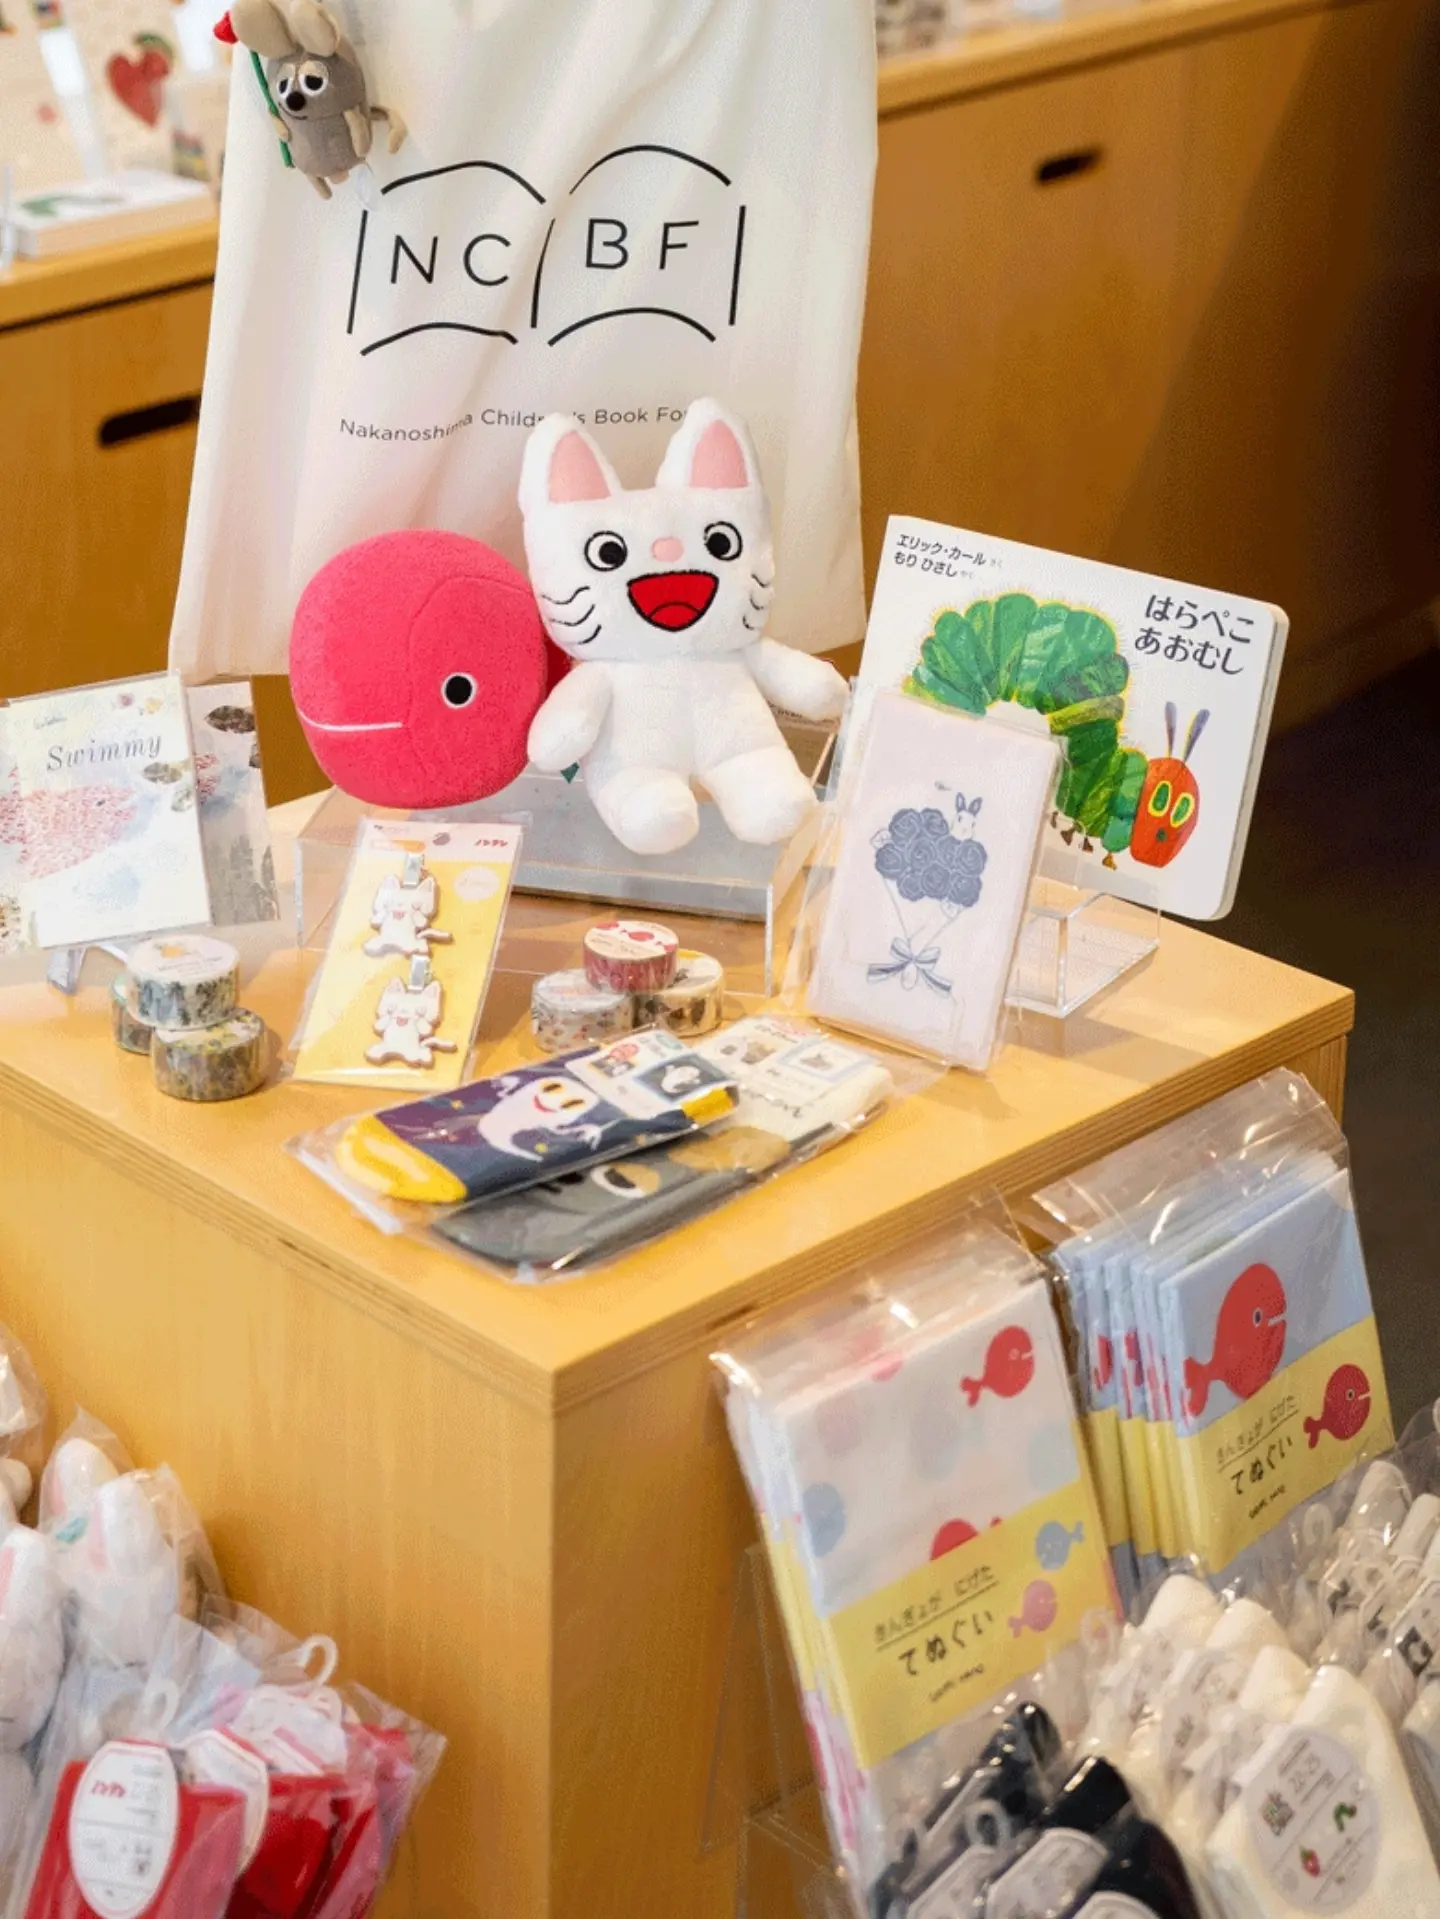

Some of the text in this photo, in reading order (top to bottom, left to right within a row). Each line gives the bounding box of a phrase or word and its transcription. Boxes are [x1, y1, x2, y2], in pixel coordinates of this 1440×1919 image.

[339, 414, 473, 441] Nakanoshima
[594, 408, 648, 425] Book
[894, 551, 918, 568] もり
[921, 558, 958, 577] ひさし
[896, 534, 987, 566] エリック・カール
[1145, 594, 1254, 644] はらぺこ
[1135, 627, 1244, 675] あおむし
[46, 735, 161, 771] Swimmy
[1230, 1435, 1294, 1495] てぬぐい
[898, 1610, 994, 1676] てぬぐい
